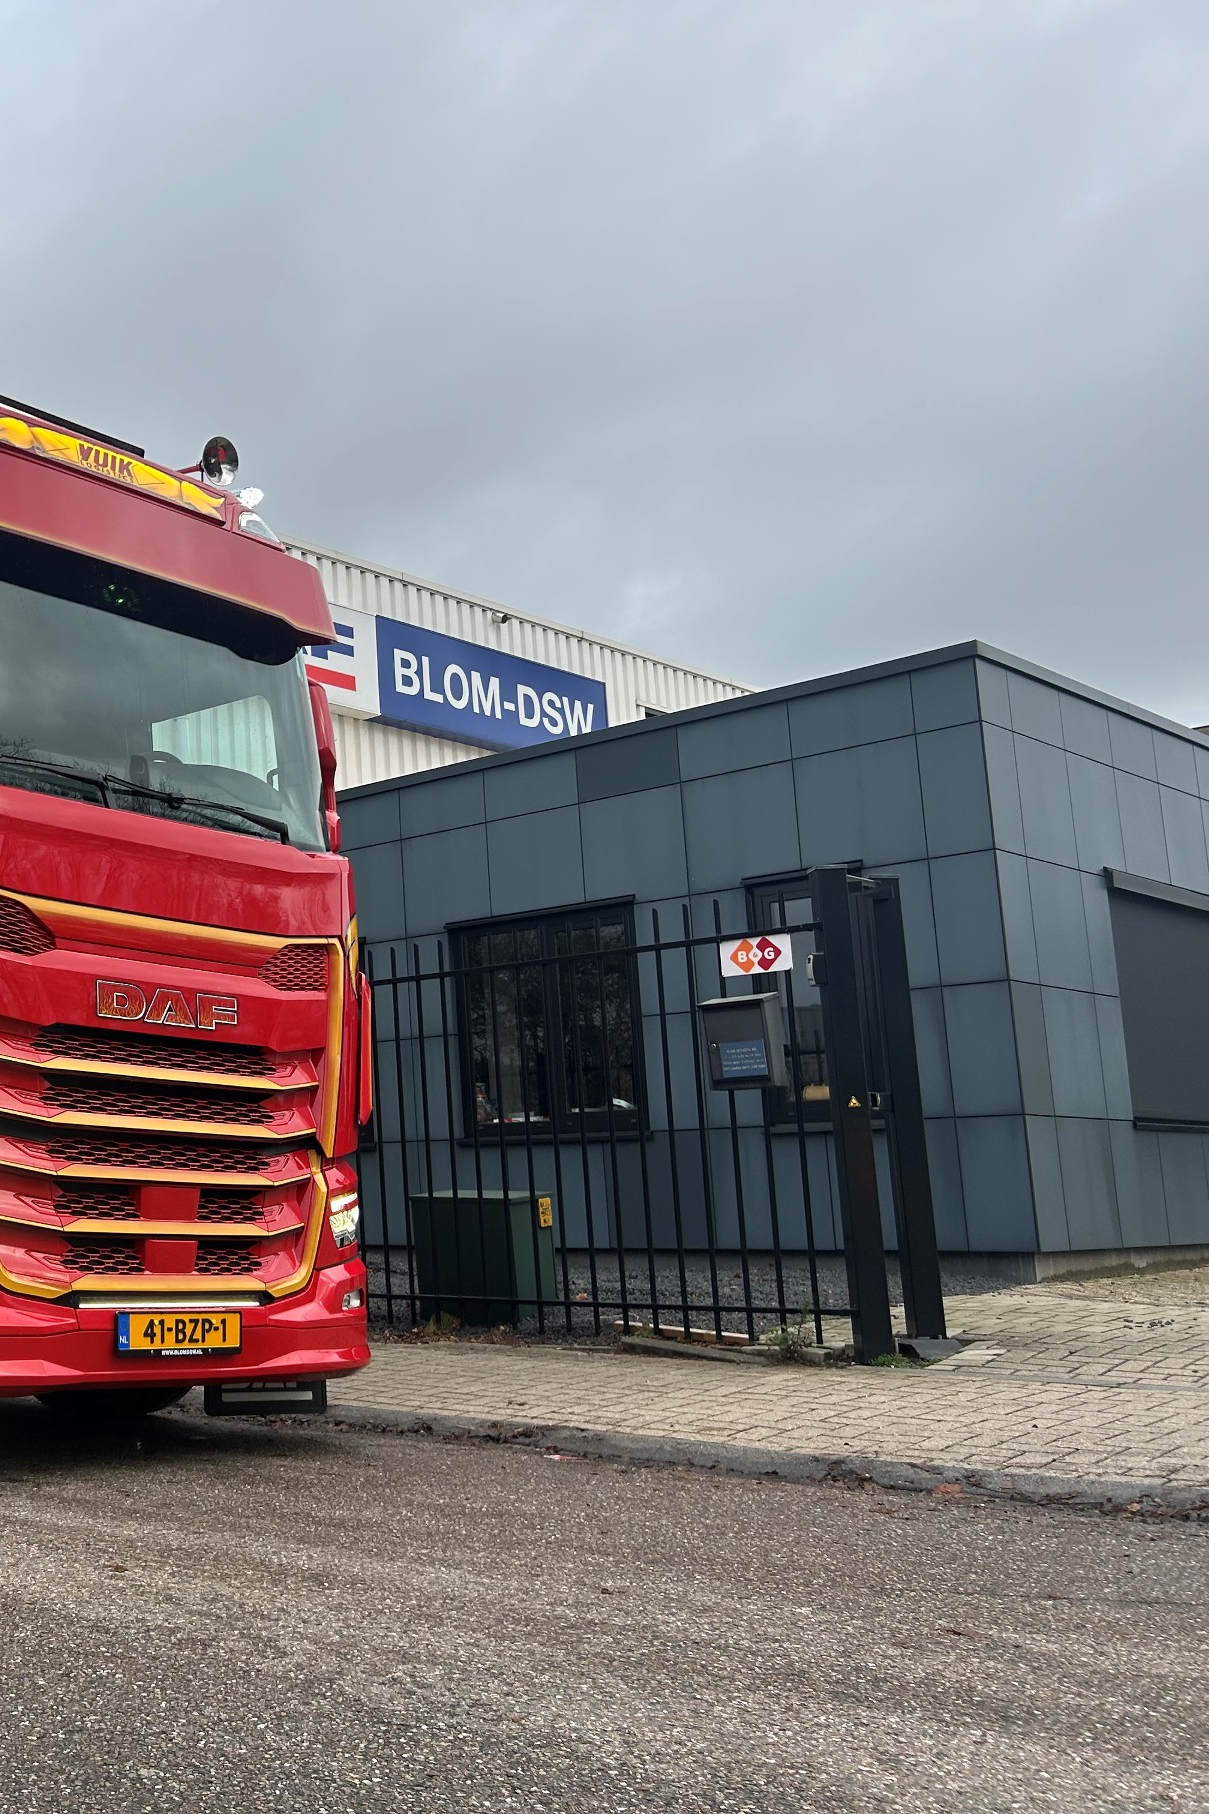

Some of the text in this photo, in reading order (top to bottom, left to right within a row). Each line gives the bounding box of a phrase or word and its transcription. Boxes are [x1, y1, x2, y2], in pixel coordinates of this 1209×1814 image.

[79, 443, 133, 478] VUIK
[80, 460, 134, 484] LOGISTICS
[393, 648, 594, 737] BLOM-DSW
[96, 979, 238, 1030] DAF
[119, 1335, 128, 1344] NL
[143, 1318, 227, 1344] 41-BZP-1
